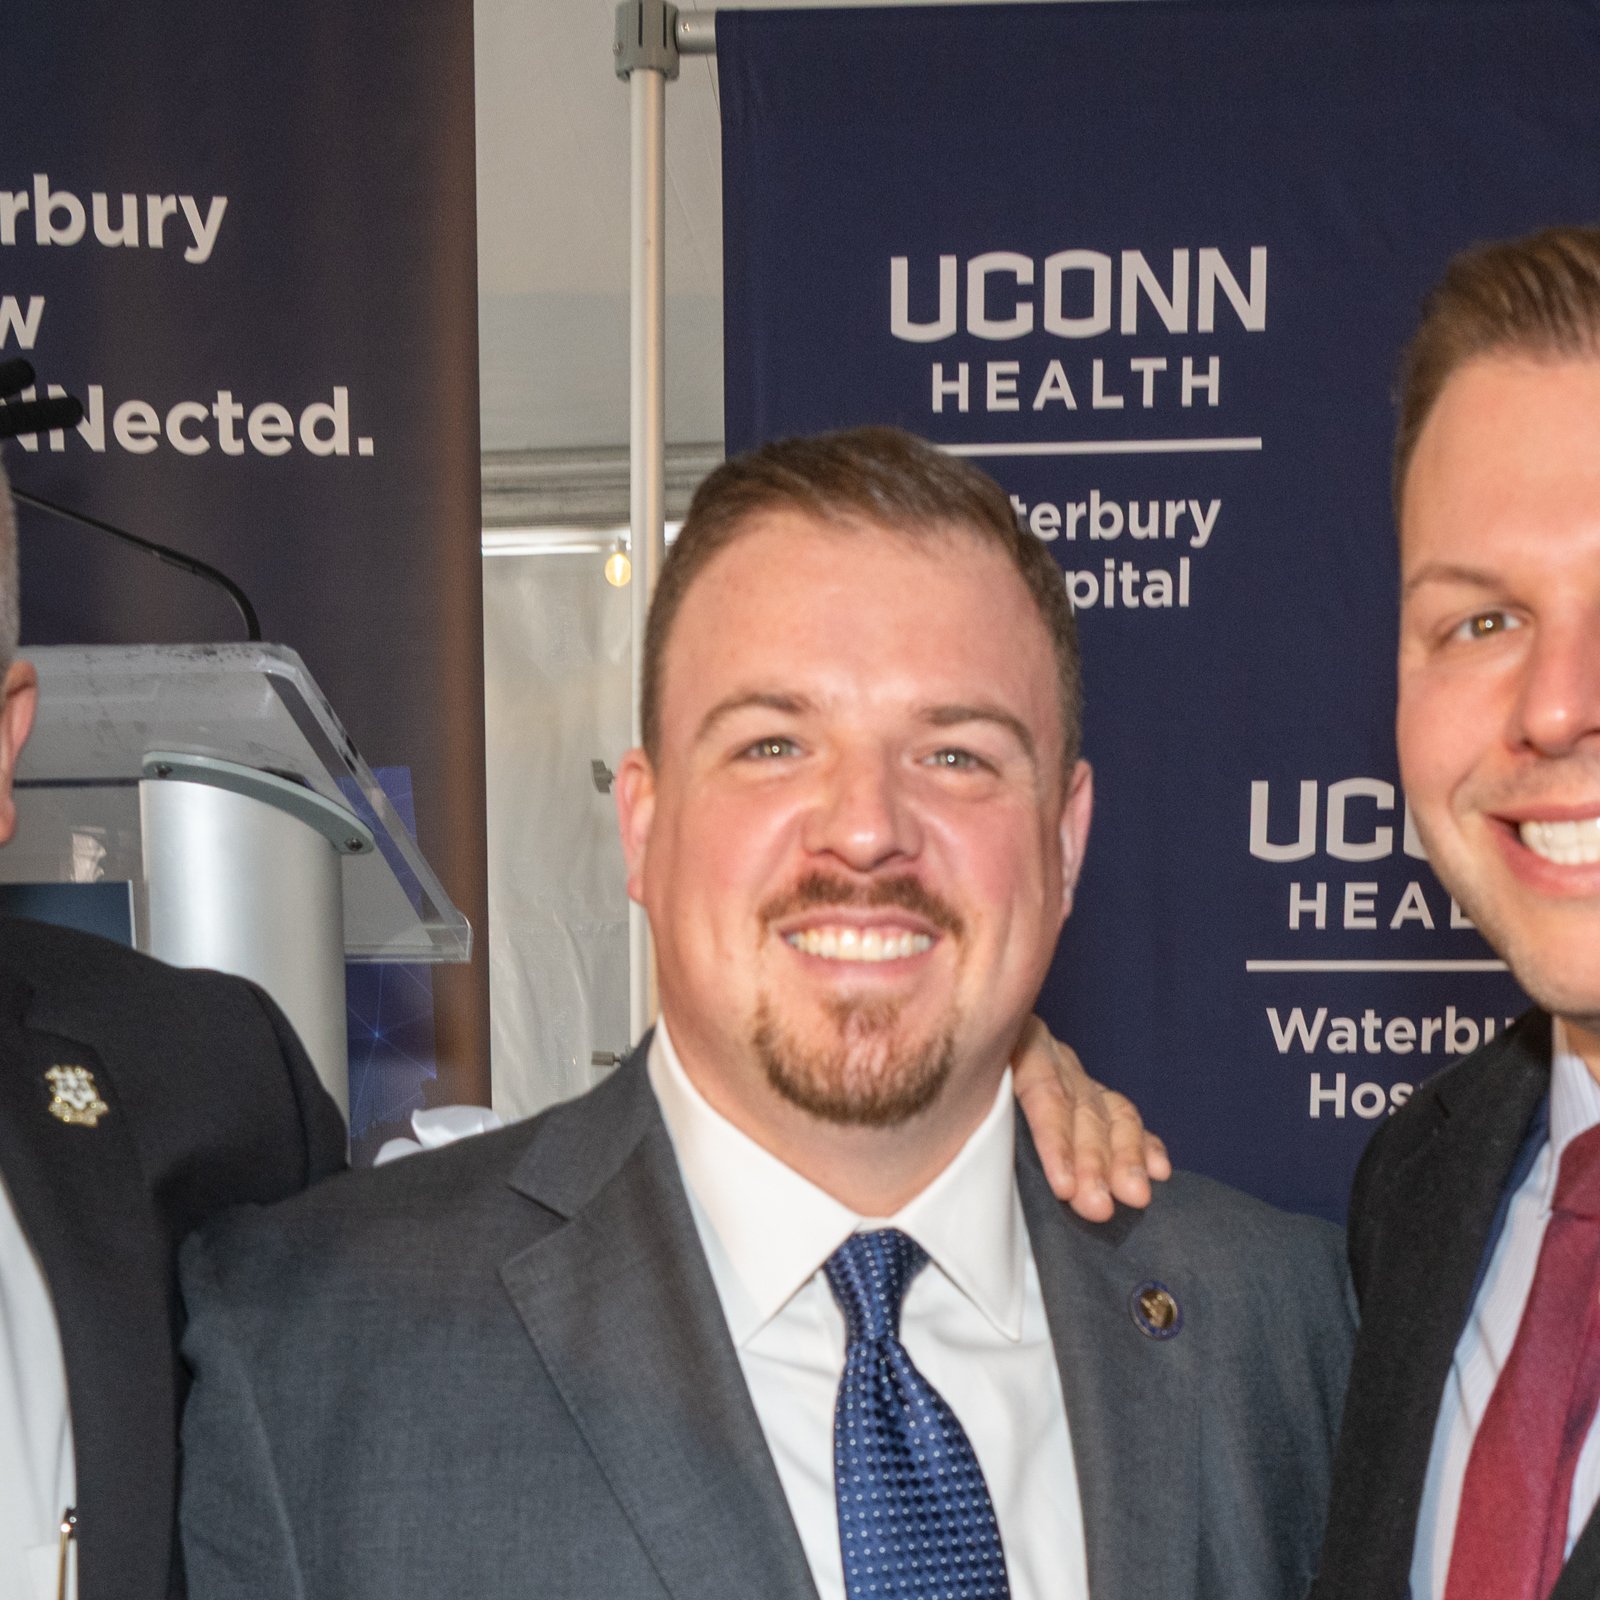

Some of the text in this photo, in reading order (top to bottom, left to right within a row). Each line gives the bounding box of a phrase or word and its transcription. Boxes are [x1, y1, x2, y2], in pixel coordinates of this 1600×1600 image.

[890, 246, 1268, 343] UCONN
[931, 356, 1220, 413] HEALTH
[1065, 556, 1191, 616] pital
